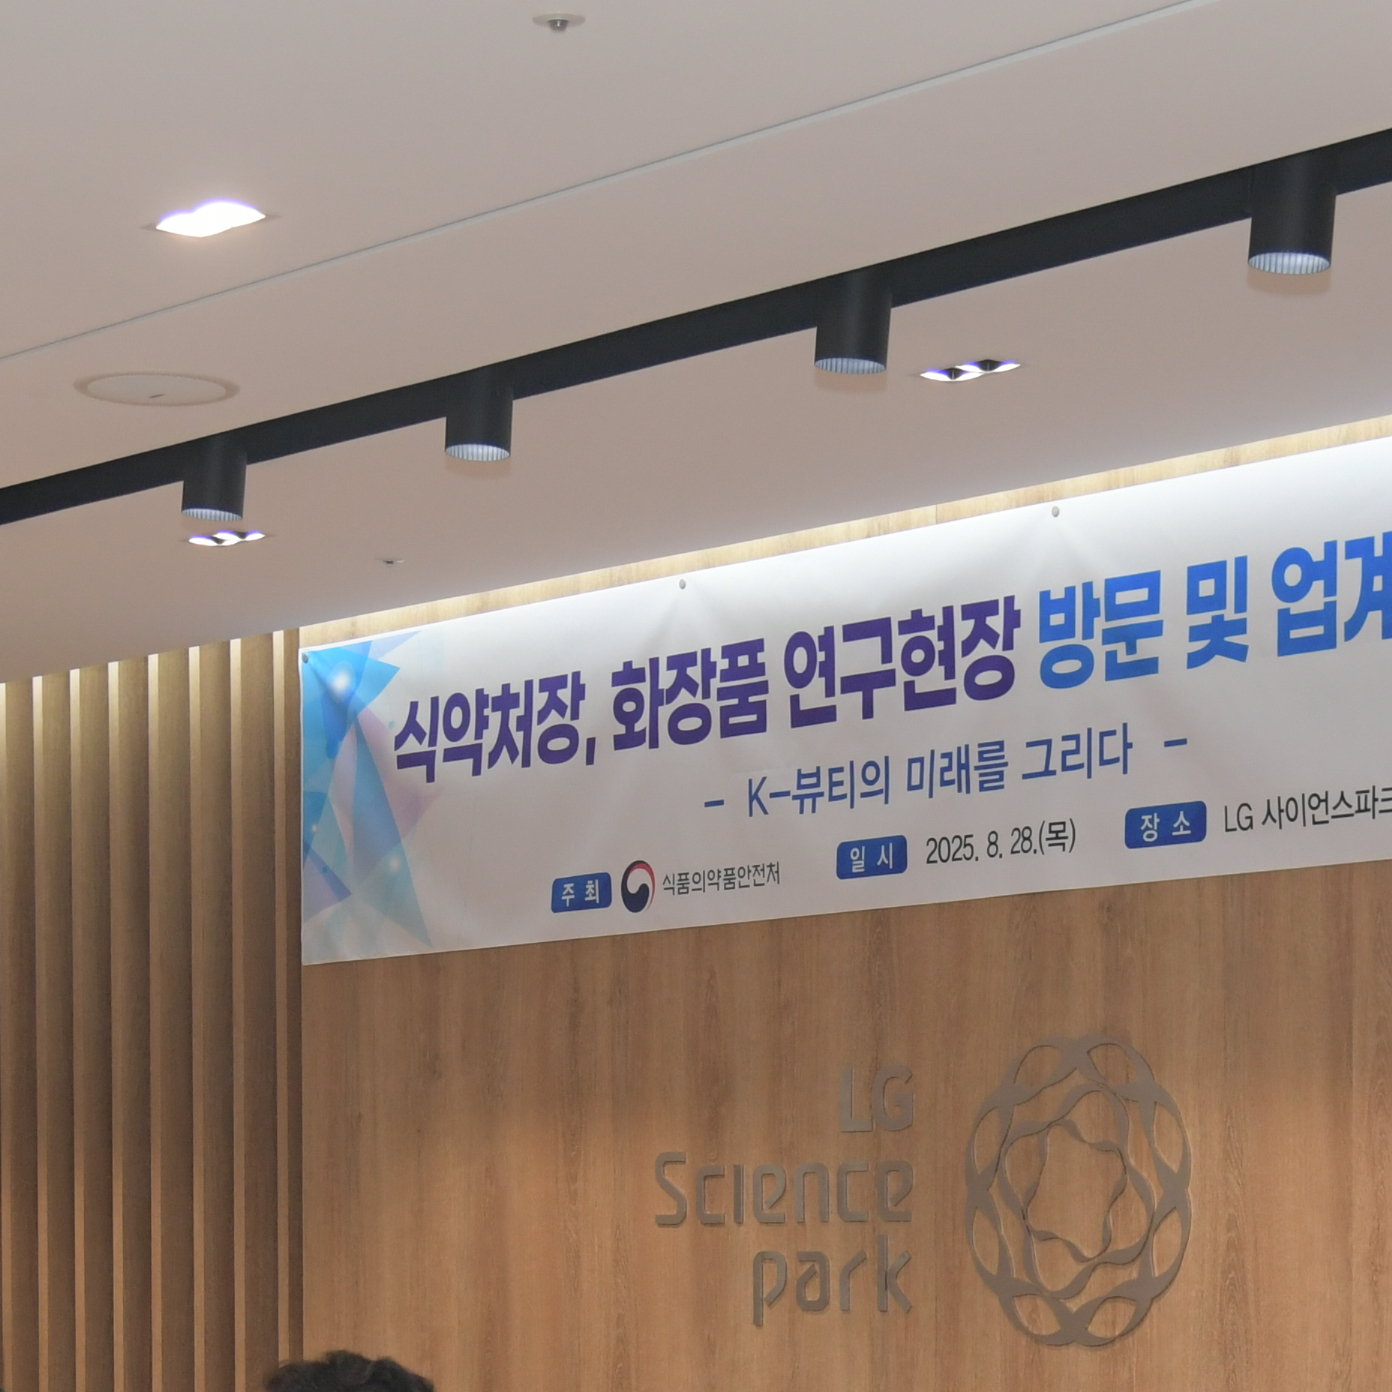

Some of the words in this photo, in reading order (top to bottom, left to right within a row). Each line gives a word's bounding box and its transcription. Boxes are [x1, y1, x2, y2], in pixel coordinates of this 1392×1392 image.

[393, 670, 597, 783] 식약처장,
[611, 638, 769, 751] 화장품
[783, 595, 1022, 730] 연구현장
[1038, 569, 1165, 691] 방문
[1185, 554, 1250, 670] 및
[747, 755, 891, 818] K-뷰티의
[906, 739, 1010, 799] 미래를
[1020, 722, 1135, 780] 그리다
[1224, 802, 1254, 833] LG
[662, 861, 781, 897] 식품의약품안전처
[839, 1065, 915, 1133] LG
[655, 1152, 914, 1227] Science
[752, 1234, 912, 1328] park
